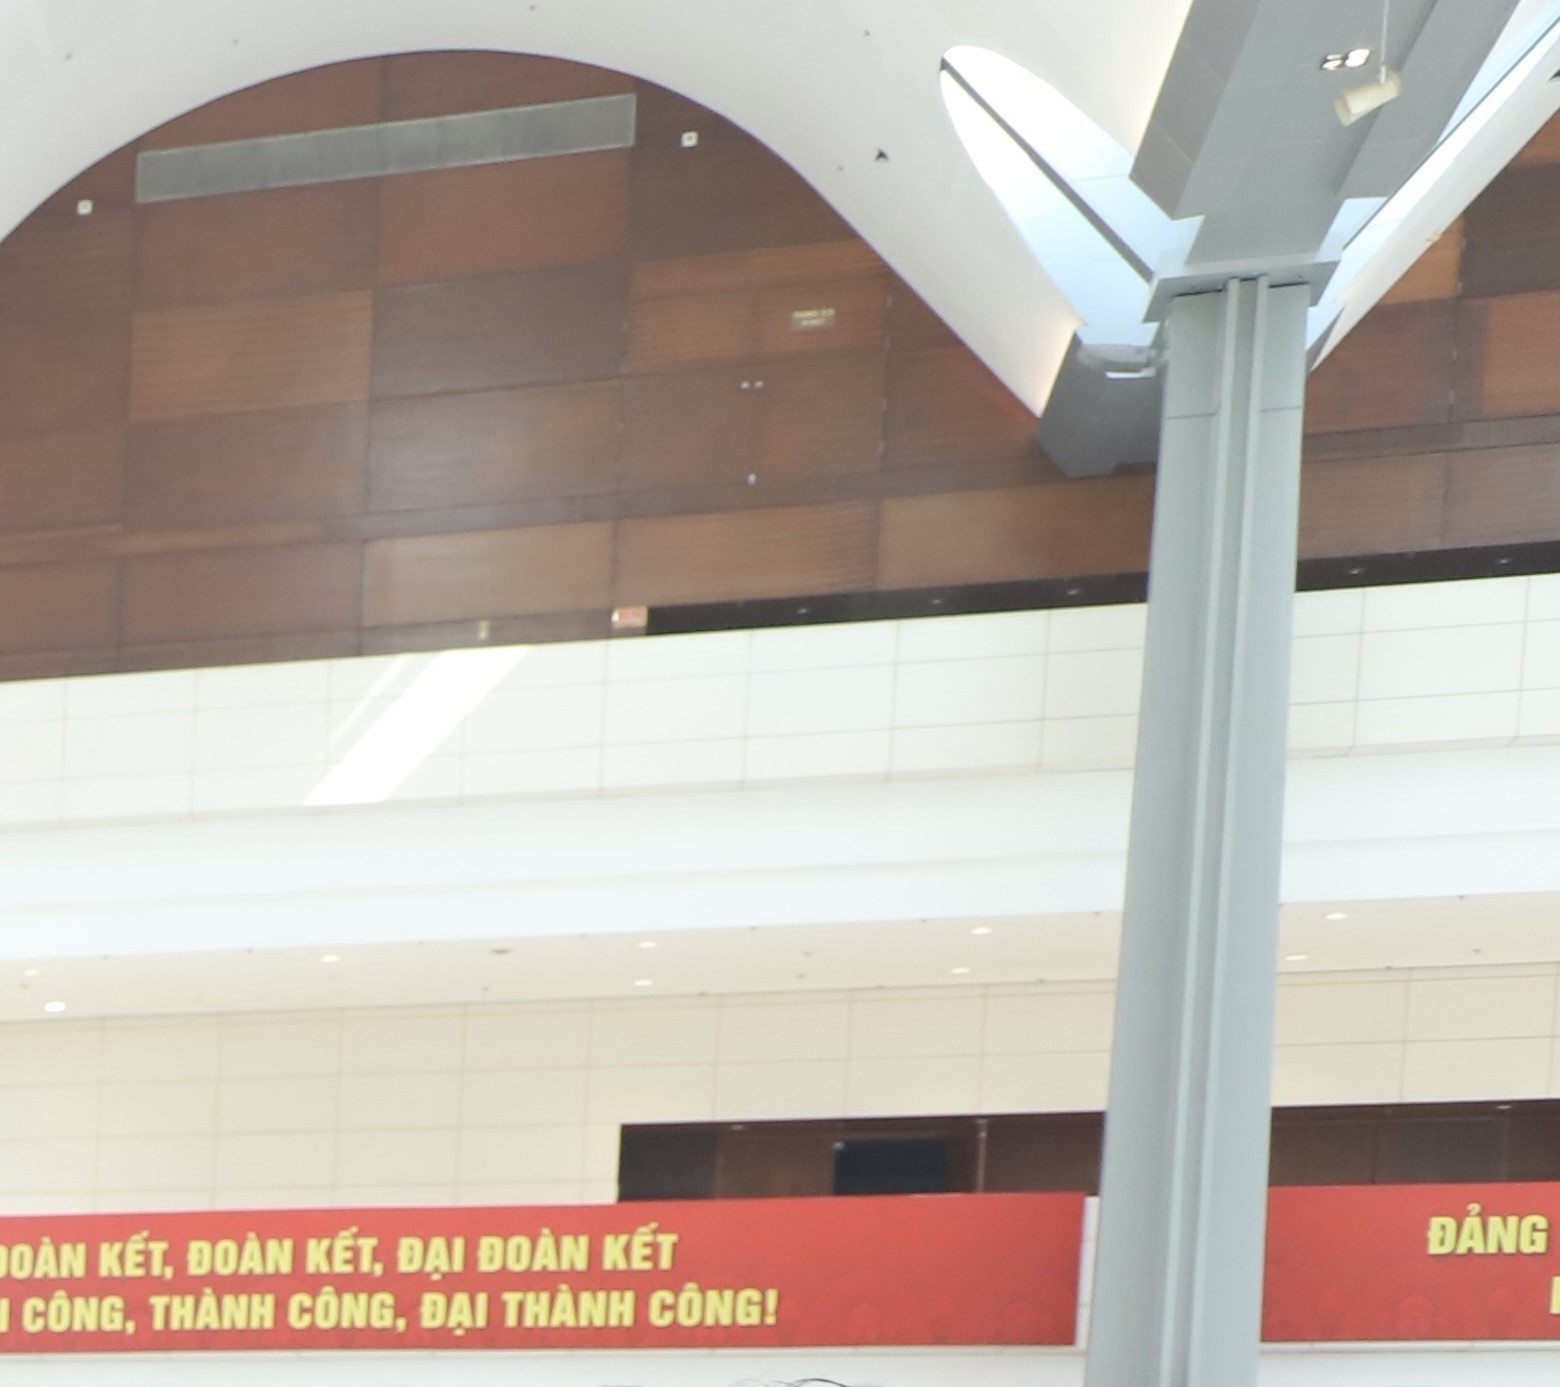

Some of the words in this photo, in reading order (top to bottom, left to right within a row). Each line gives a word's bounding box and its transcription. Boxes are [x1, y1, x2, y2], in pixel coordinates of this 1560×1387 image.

[99, 1230, 174, 1281] KẾT,
[186, 1231, 294, 1277] ĐOÀN
[305, 1226, 384, 1277] KẾT,
[397, 1236, 465, 1281] ĐẠI
[477, 1227, 589, 1273] ĐOÀN
[602, 1222, 679, 1271] KẾT
[1427, 1202, 1550, 1255] ĐẢNG
[22, 1290, 136, 1335] CÔNG,
[150, 1287, 275, 1331] THÀNH
[287, 1285, 407, 1333] CÔNG,
[419, 1291, 488, 1337] ĐẠI
[501, 1283, 636, 1329] THÀNH
[648, 1282, 778, 1328] CÔNG!
